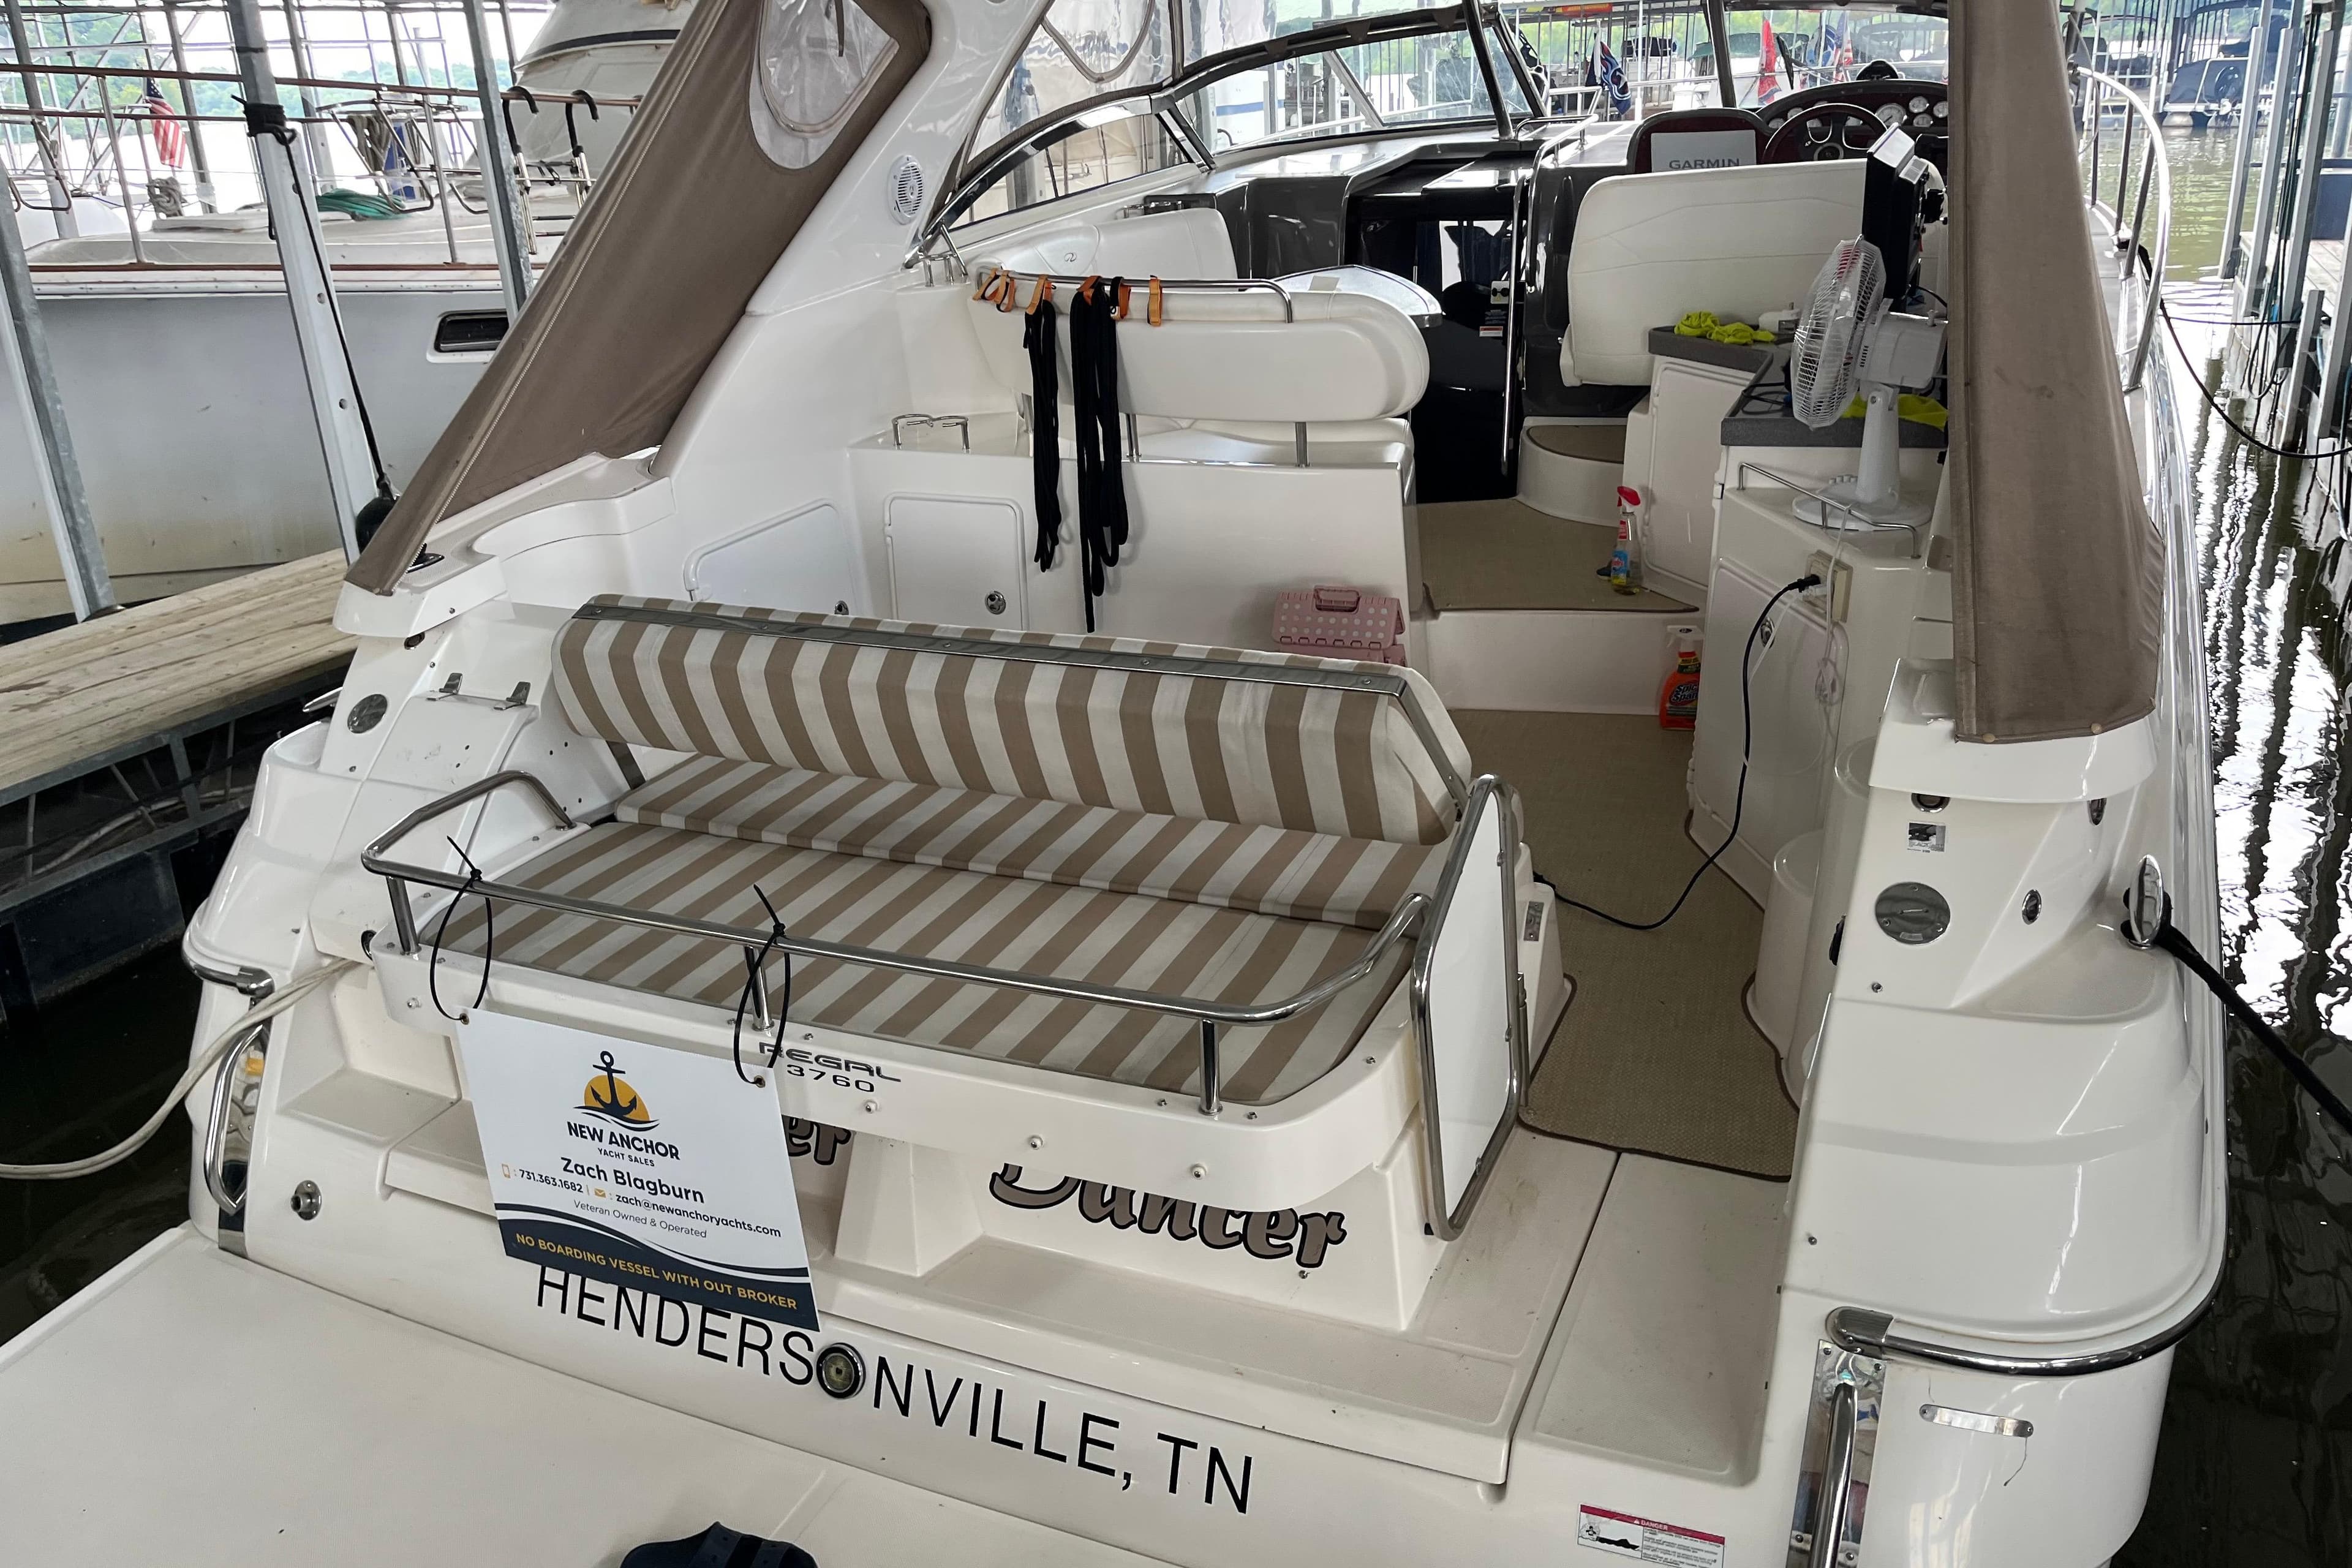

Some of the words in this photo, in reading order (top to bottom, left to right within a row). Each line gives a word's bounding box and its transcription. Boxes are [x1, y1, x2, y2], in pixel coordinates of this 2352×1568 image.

[1669, 158, 1740, 170] GARMIN
[759, 1042, 901, 1082] REGAL
[786, 1064, 875, 1092] 3760
[567, 1121, 603, 1143] NEW
[609, 1131, 680, 1160] ANCHOR
[598, 1147, 625, 1160] YACHT
[628, 1155, 655, 1167] SALES
[560, 1157, 608, 1182] Zach
[613, 1169, 704, 1204] Blagburn
[519, 1169, 583, 1193] 731.363.1682
[616, 1194, 781, 1237] zach@newanchoryachts.com
[574, 1199, 610, 1216] Veteran
[612, 1210, 647, 1225] Owned
[650, 1218, 657, 1227] &
[660, 1221, 707, 1238] Operated
[516, 1233, 535, 1246] NO
[538, 1239, 606, 1265] BOARDING
[609, 1257, 660, 1279] VESSEL
[662, 1270, 699, 1288] WITH
[704, 1280, 732, 1295] OUT
[737, 1287, 797, 1310] BROKER
[1157, 1432, 1253, 1515] TN
[1641, 1520, 1668, 1531] DANGER
